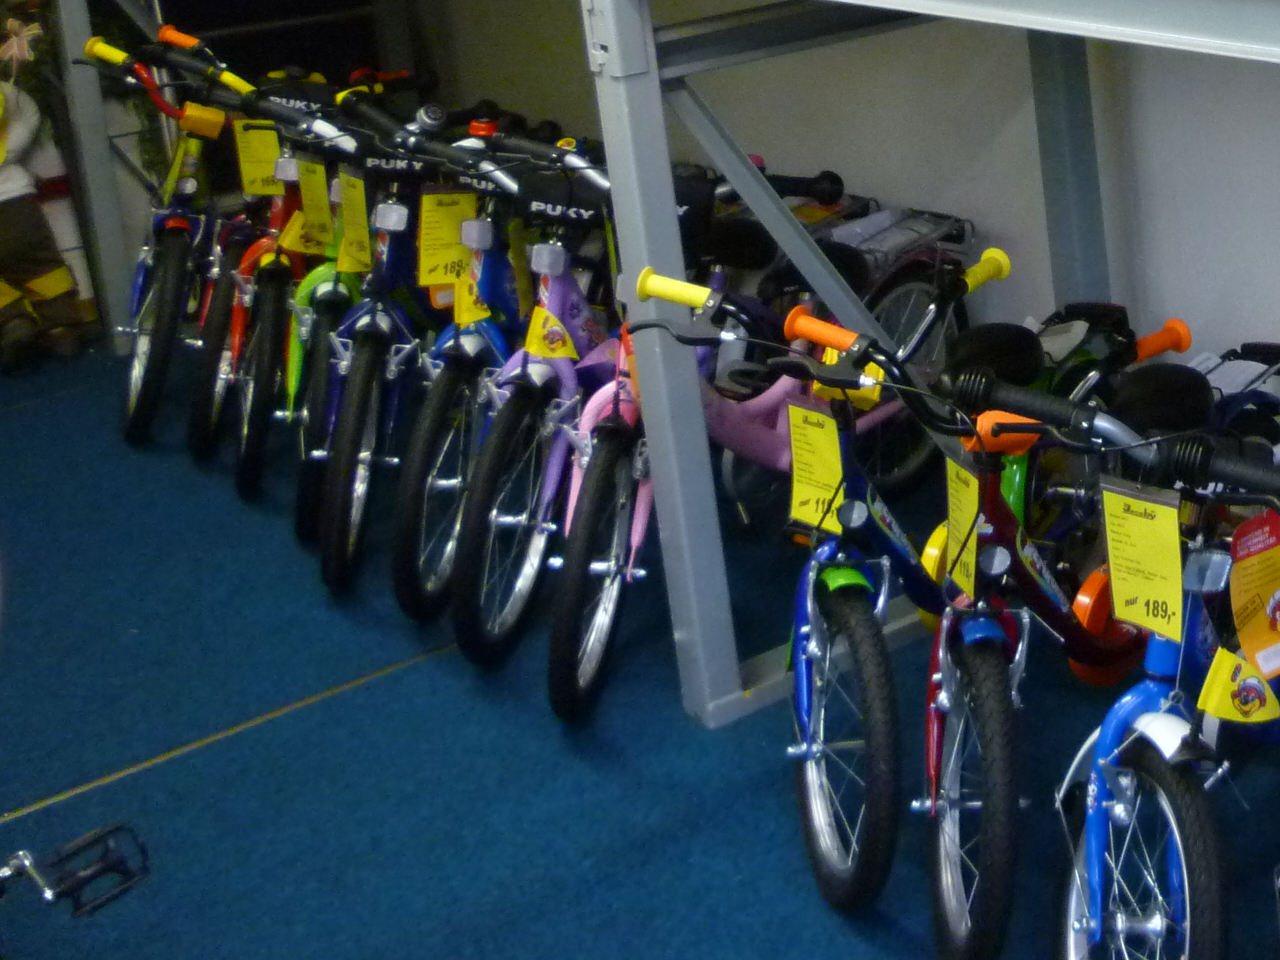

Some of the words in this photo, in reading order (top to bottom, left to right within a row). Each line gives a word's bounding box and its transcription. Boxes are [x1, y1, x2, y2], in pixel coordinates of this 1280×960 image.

[366, 157, 424, 171] PUKY
[459, 176, 496, 190] PUK
[531, 201, 595, 219] PUKY
[1124, 596, 1139, 607] nur
[1144, 598, 1176, 625] 189,-
